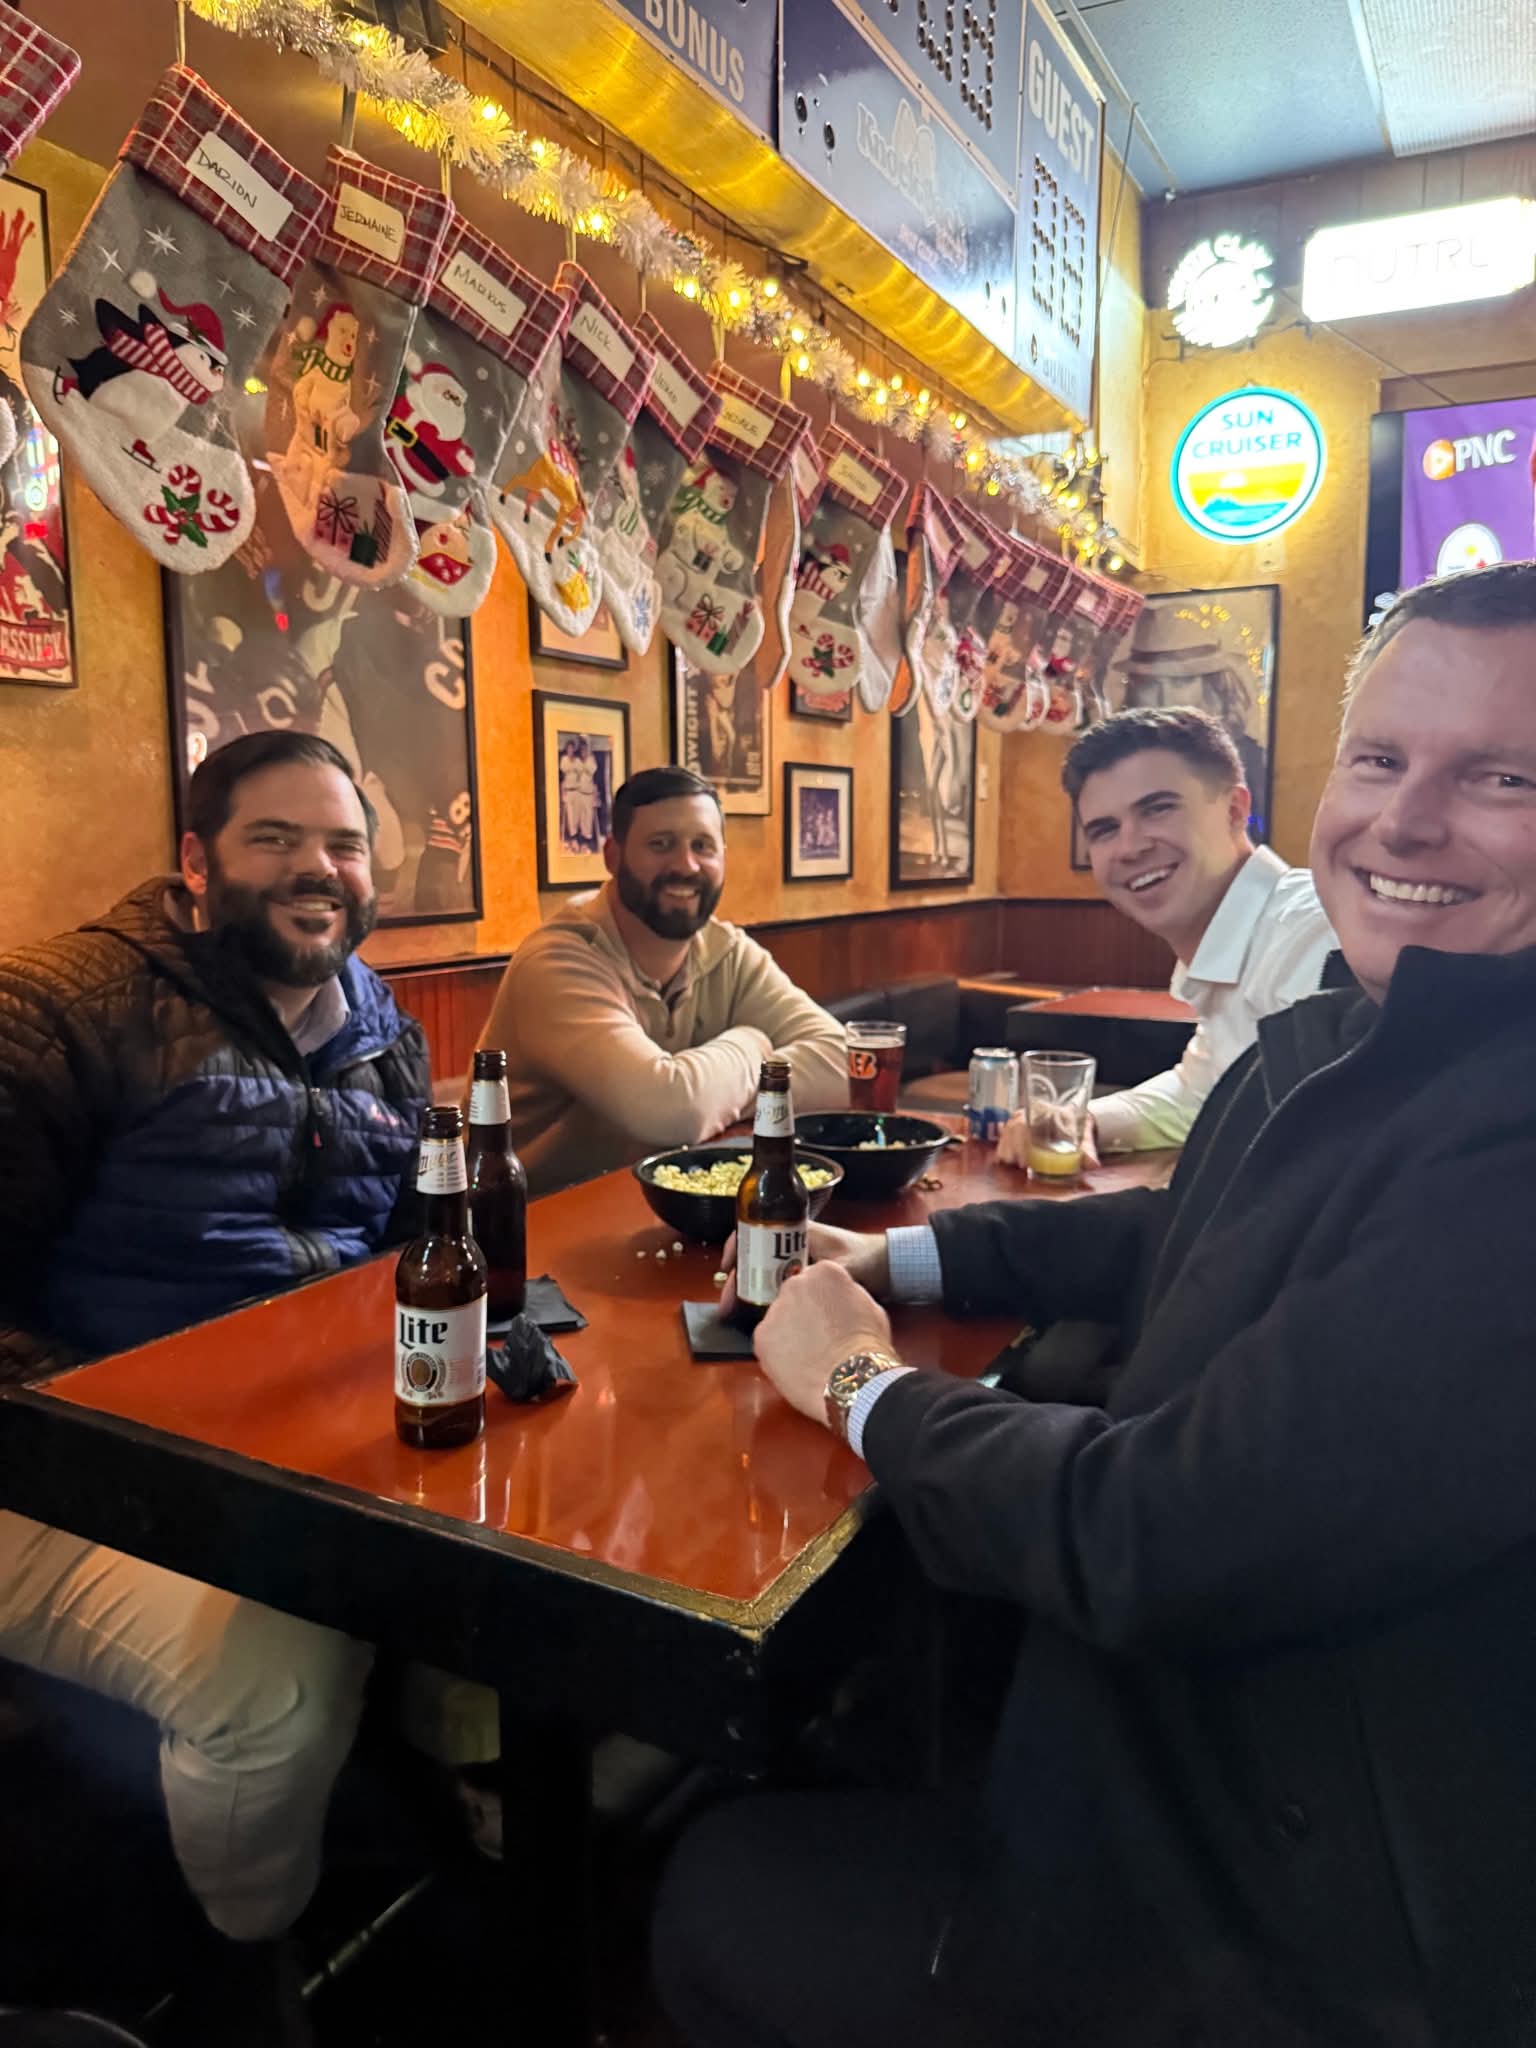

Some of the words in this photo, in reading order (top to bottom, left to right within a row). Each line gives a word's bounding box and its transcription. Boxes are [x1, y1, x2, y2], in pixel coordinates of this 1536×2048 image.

[1029, 39, 1094, 184] GUEST
[1221, 408, 1274, 430] SUN
[1191, 431, 1303, 459] CRUISER
[1453, 429, 1517, 472] PNC
[398, 1311, 449, 1350] Lite
